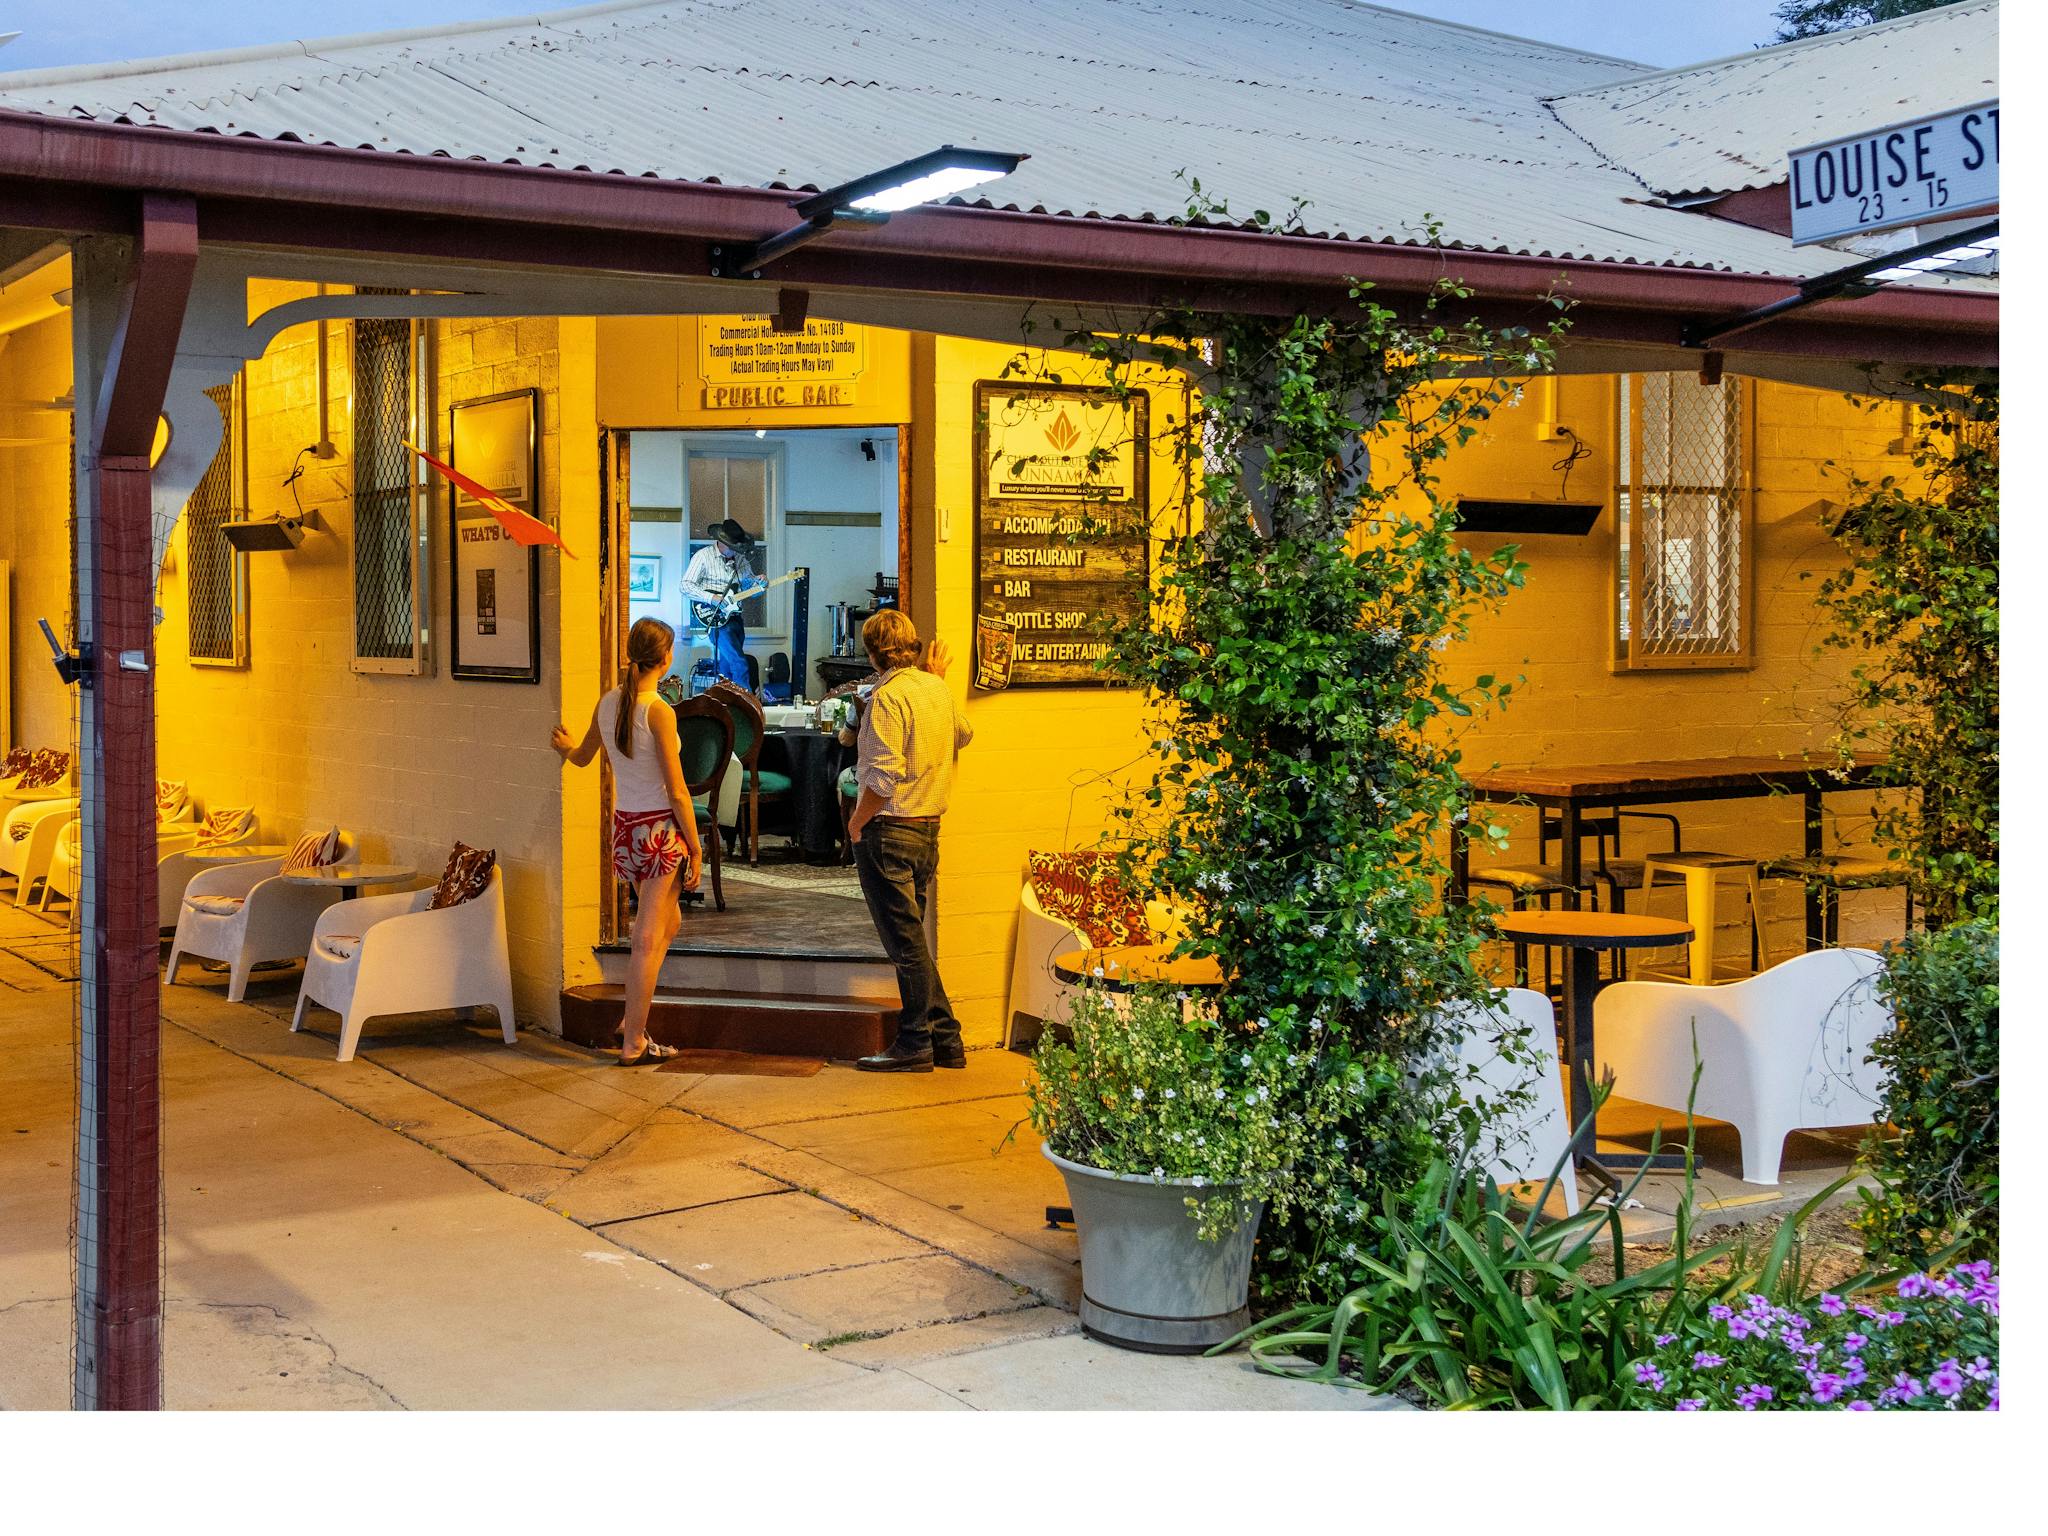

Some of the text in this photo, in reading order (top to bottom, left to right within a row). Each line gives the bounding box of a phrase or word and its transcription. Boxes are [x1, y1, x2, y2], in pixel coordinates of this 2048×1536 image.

[1793, 126, 1935, 210] LOUISE
[1858, 193, 1884, 223] 23
[1926, 178, 1948, 208] 15
[720, 325, 760, 339] Commercial
[807, 323, 818, 336] No.
[820, 322, 844, 336] 141819
[709, 339, 856, 358] Trading Hours 10am-12am Monday to Sunday
[730, 357, 834, 375] (Actual Trading Hours May Vary)
[716, 384, 840, 407] PUBLIC BAR
[1004, 549, 1083, 567] RESTAURANT
[1004, 580, 1031, 597] BAR
[1005, 612, 1052, 629] BOTTLE
[1013, 644, 1032, 660] IVE
